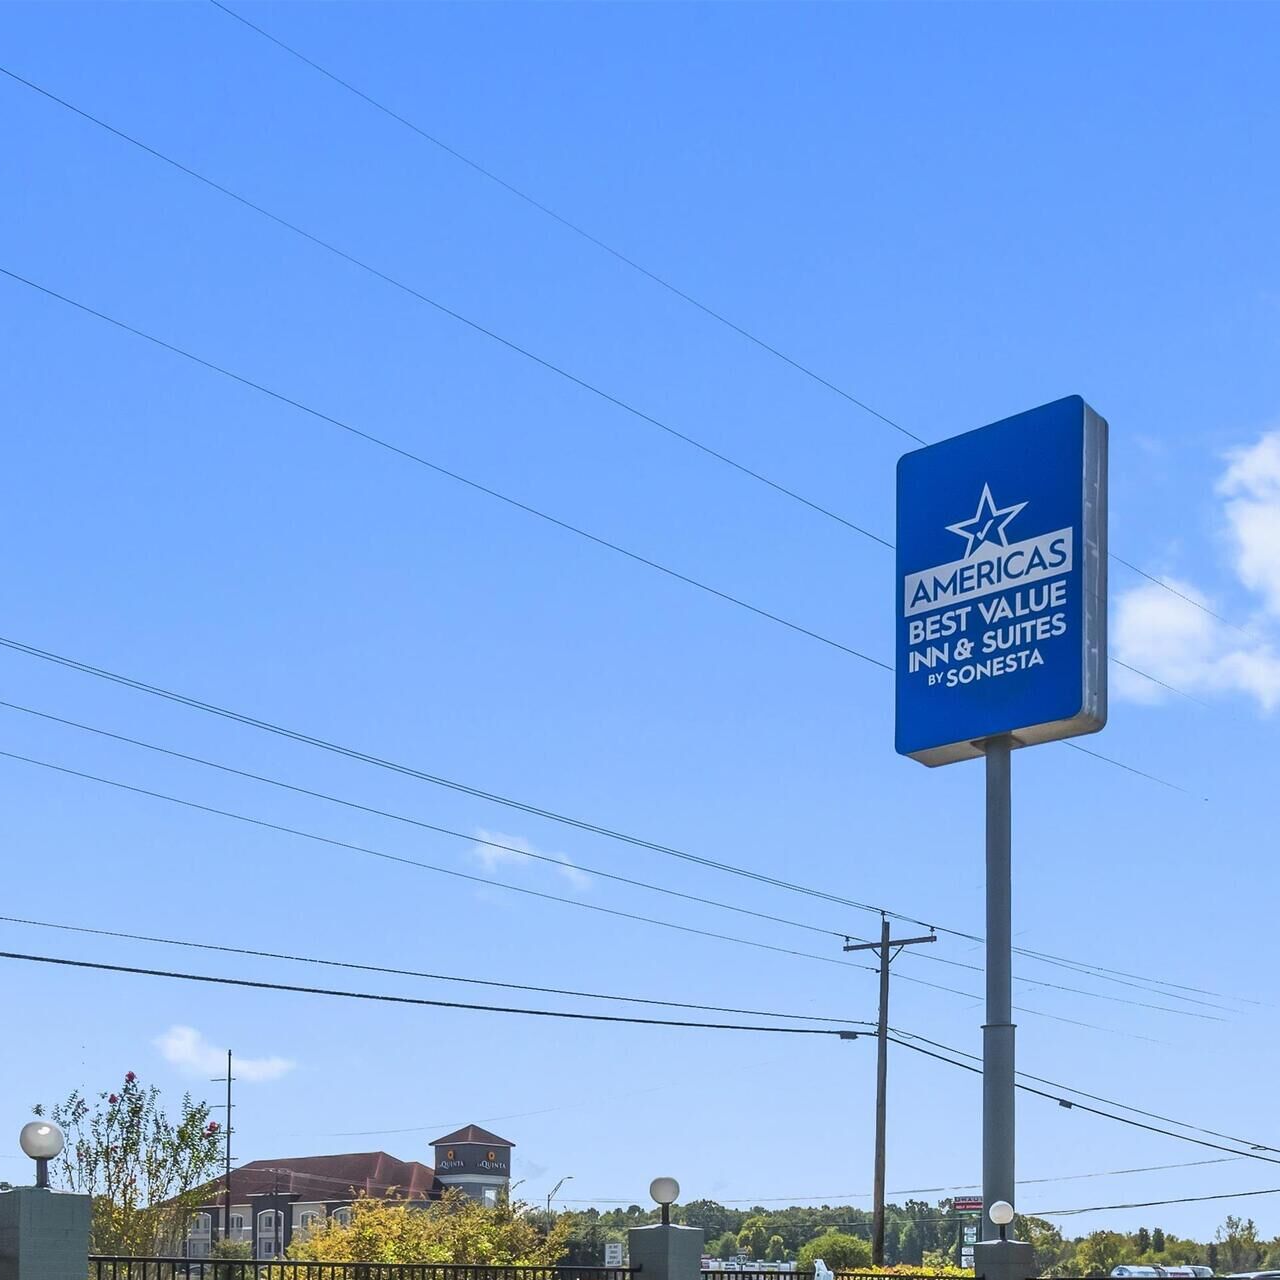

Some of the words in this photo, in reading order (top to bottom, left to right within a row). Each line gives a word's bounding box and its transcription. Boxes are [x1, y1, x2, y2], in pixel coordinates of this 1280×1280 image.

[911, 538, 1067, 607] AMERICAS
[908, 643, 949, 673] INN
[954, 635, 975, 660] &
[982, 613, 1067, 653] SUITES
[909, 606, 972, 645] BEST
[979, 580, 1067, 625] VALUE
[928, 672, 944, 686] BY
[946, 648, 1044, 688] SONESTA
